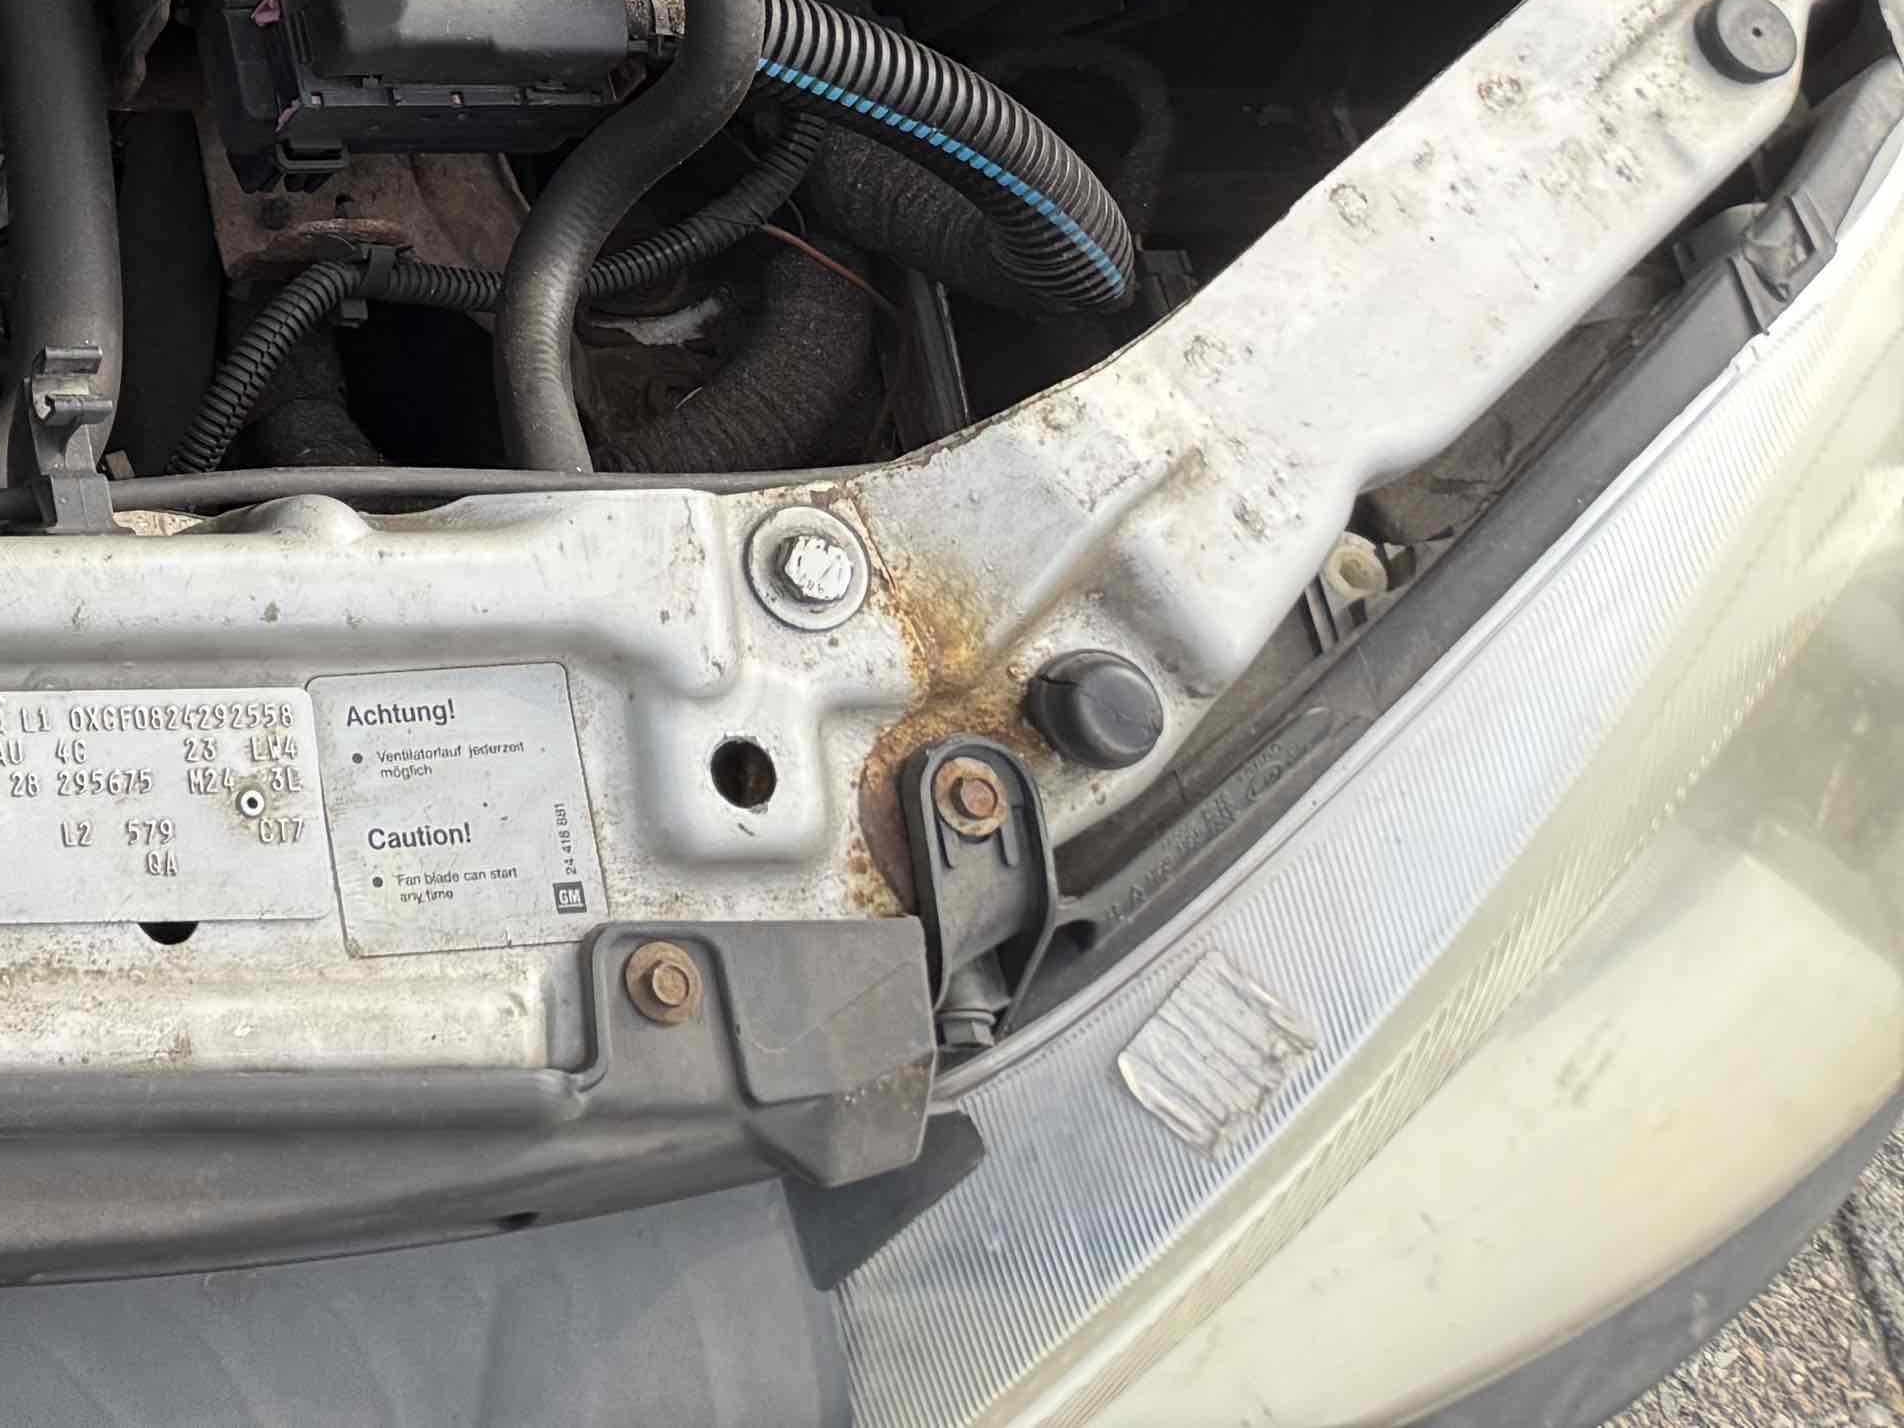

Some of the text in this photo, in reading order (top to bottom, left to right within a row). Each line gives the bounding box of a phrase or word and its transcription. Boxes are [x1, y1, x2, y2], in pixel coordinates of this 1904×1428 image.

[346, 697, 457, 728] Achtung!
[184, 738, 218, 764] 23
[250, 735, 300, 763] LW4
[379, 764, 433, 783] möglich
[127, 819, 176, 846] 579
[367, 821, 472, 851] Caution!
[396, 867, 519, 888] Fan blade can start
